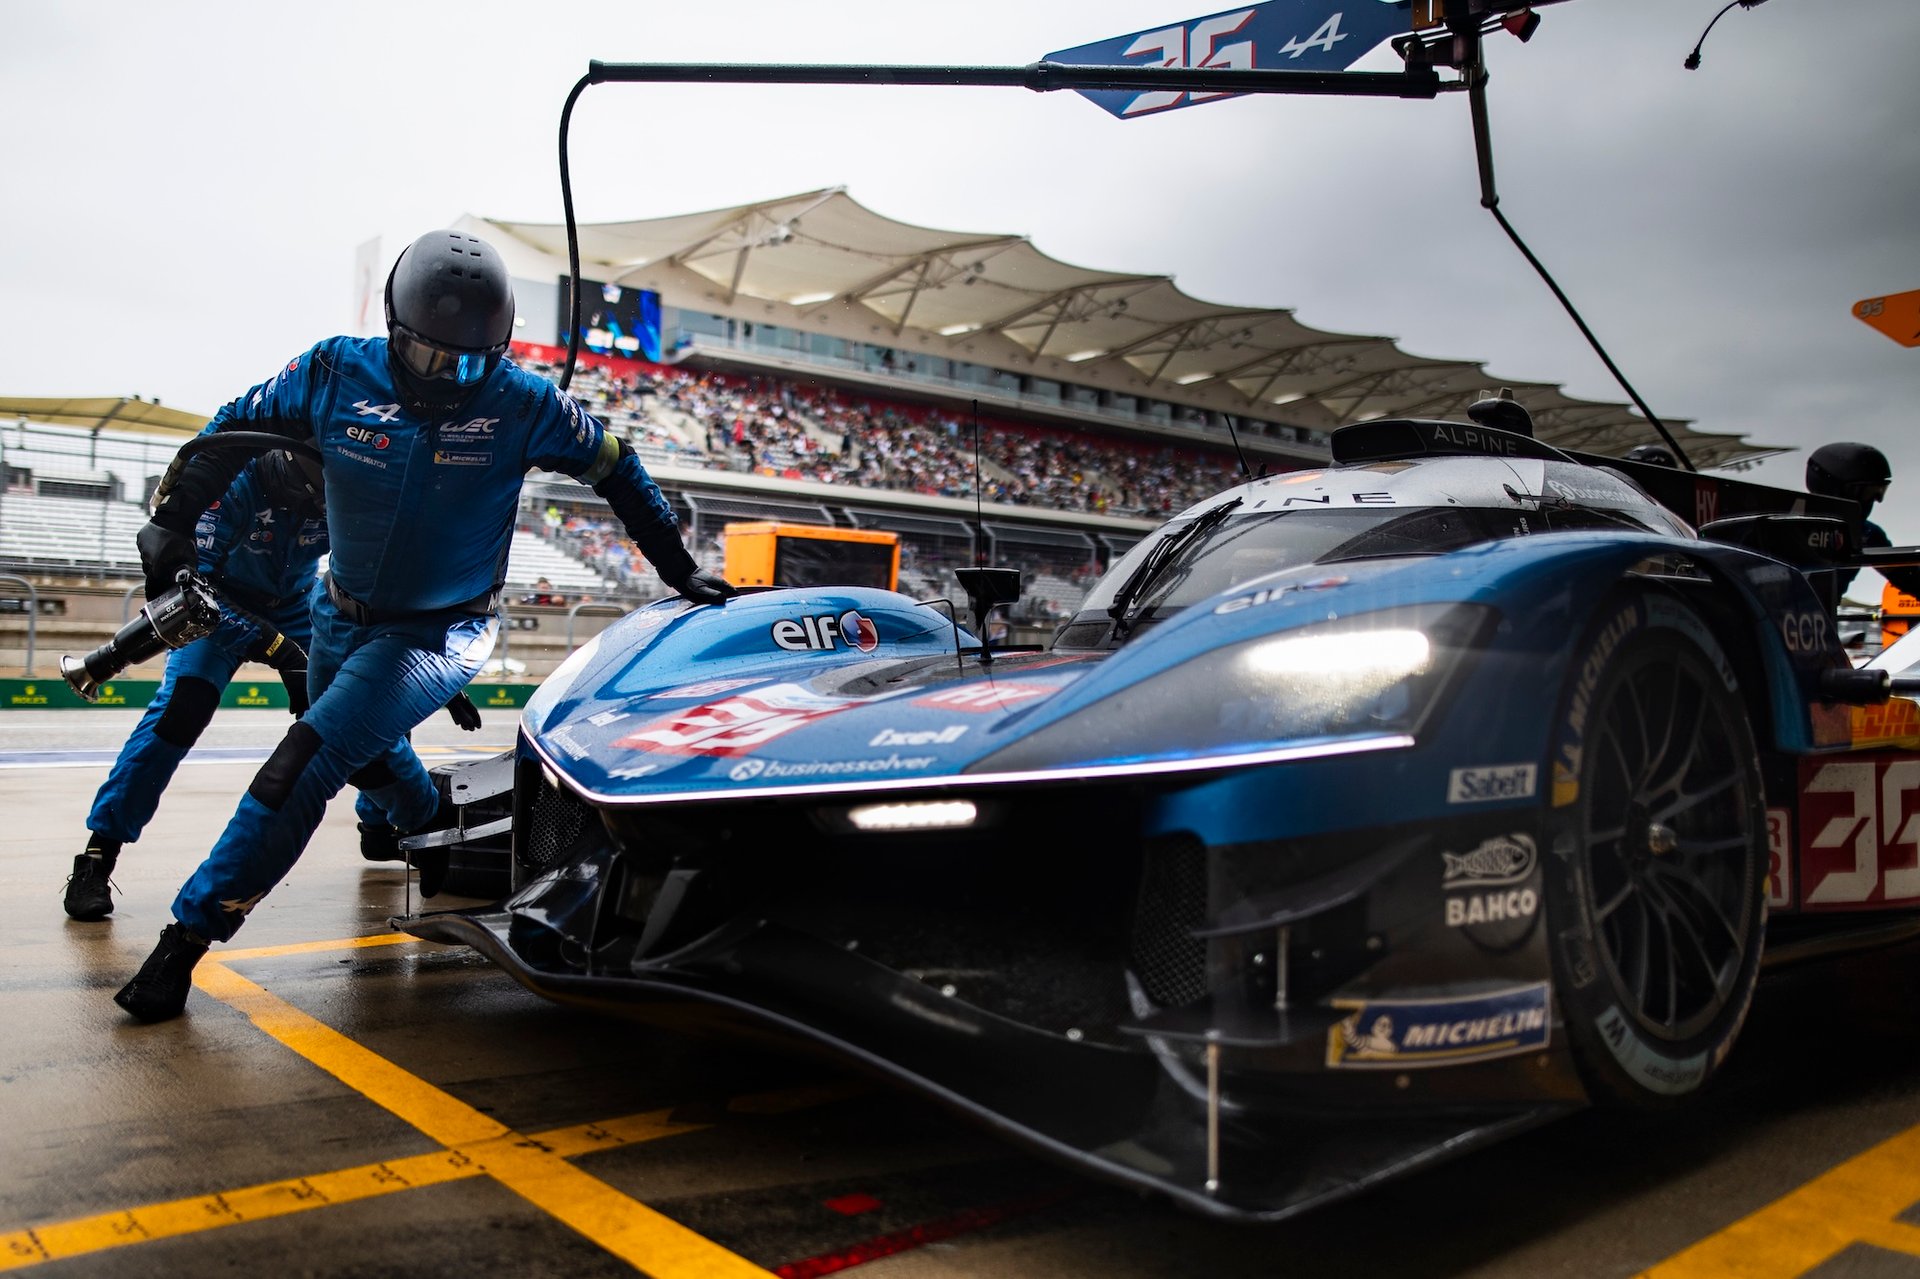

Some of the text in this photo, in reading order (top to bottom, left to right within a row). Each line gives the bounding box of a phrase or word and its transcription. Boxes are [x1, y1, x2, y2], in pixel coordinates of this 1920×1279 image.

[346, 427, 374, 443] elf
[1434, 425, 1517, 456] ALPINE
[1808, 530, 1830, 548] elf
[772, 616, 838, 650] elf
[1783, 613, 1828, 652] GCR
[1569, 606, 1639, 738] MICHELIN
[763, 754, 938, 777] businessolver
[1458, 768, 1528, 799] Sabelt
[1446, 889, 1538, 926] BAHCO
[1402, 1008, 1545, 1047] MICHELIN
